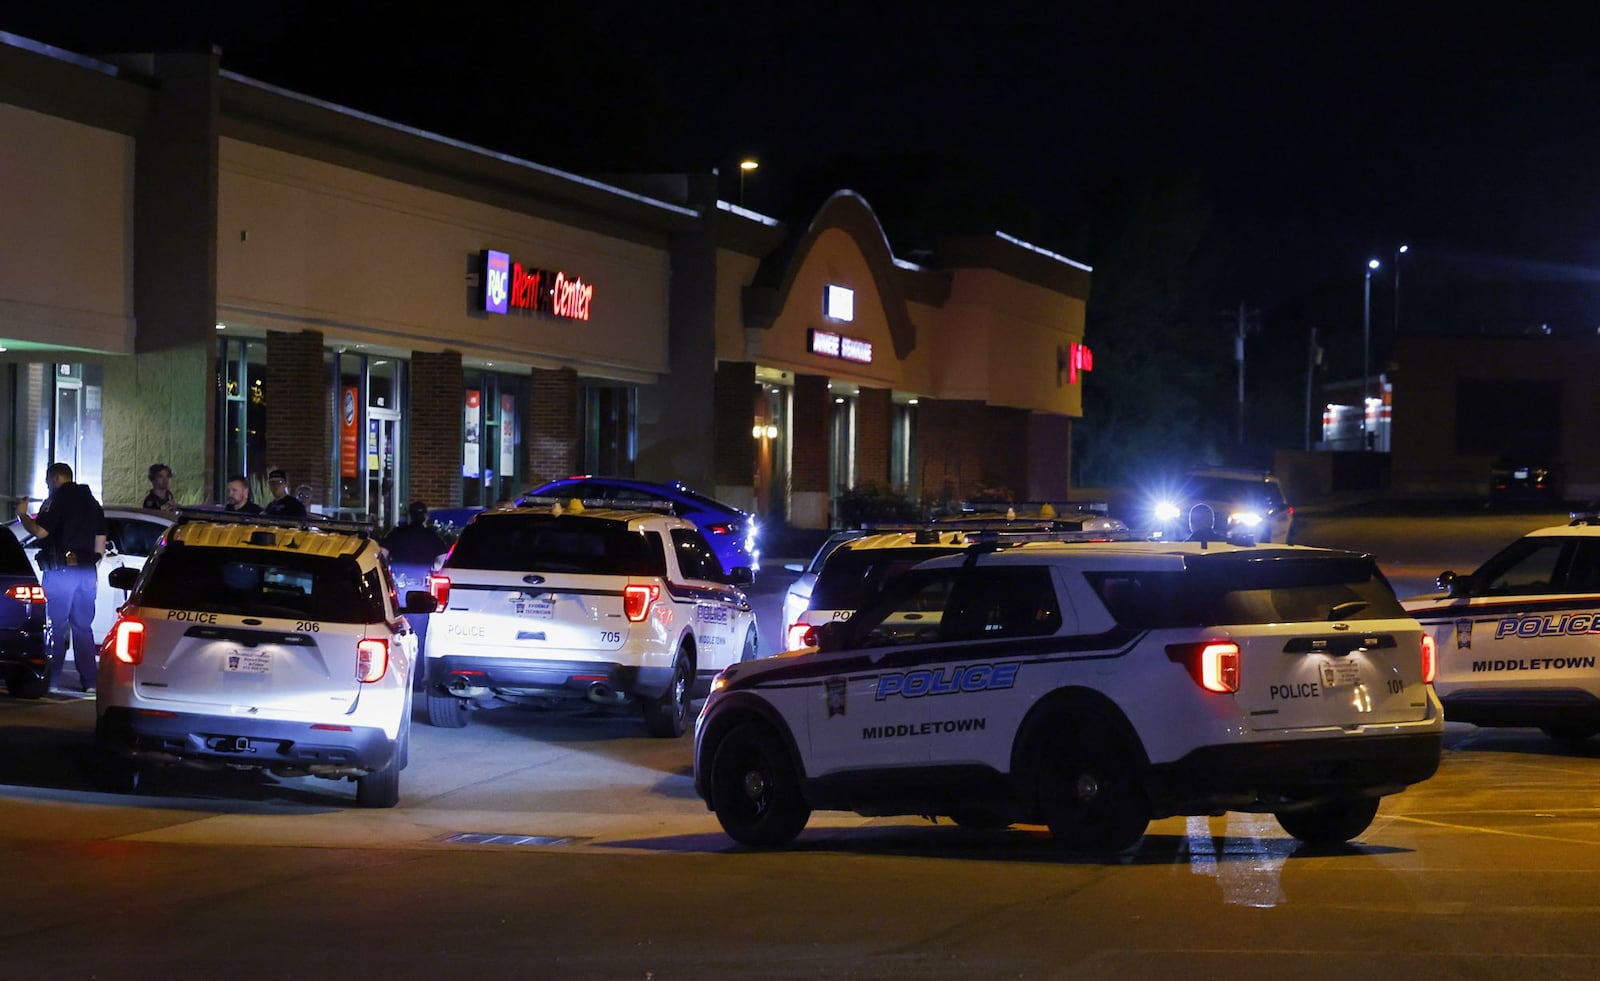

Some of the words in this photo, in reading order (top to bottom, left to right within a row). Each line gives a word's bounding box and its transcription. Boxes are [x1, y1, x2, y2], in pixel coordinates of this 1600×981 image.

[553, 271, 593, 321] Center
[167, 610, 218, 625] POLICE
[296, 621, 320, 633] 206
[447, 624, 486, 637] POLICE
[600, 631, 620, 643] 705
[1472, 656, 1596, 672] MIDDLETOWN
[875, 660, 1022, 702] POLICE
[1387, 679, 1405, 695] 101
[1270, 682, 1320, 700] POLICE
[862, 717, 986, 741] MIDDLETOWN
